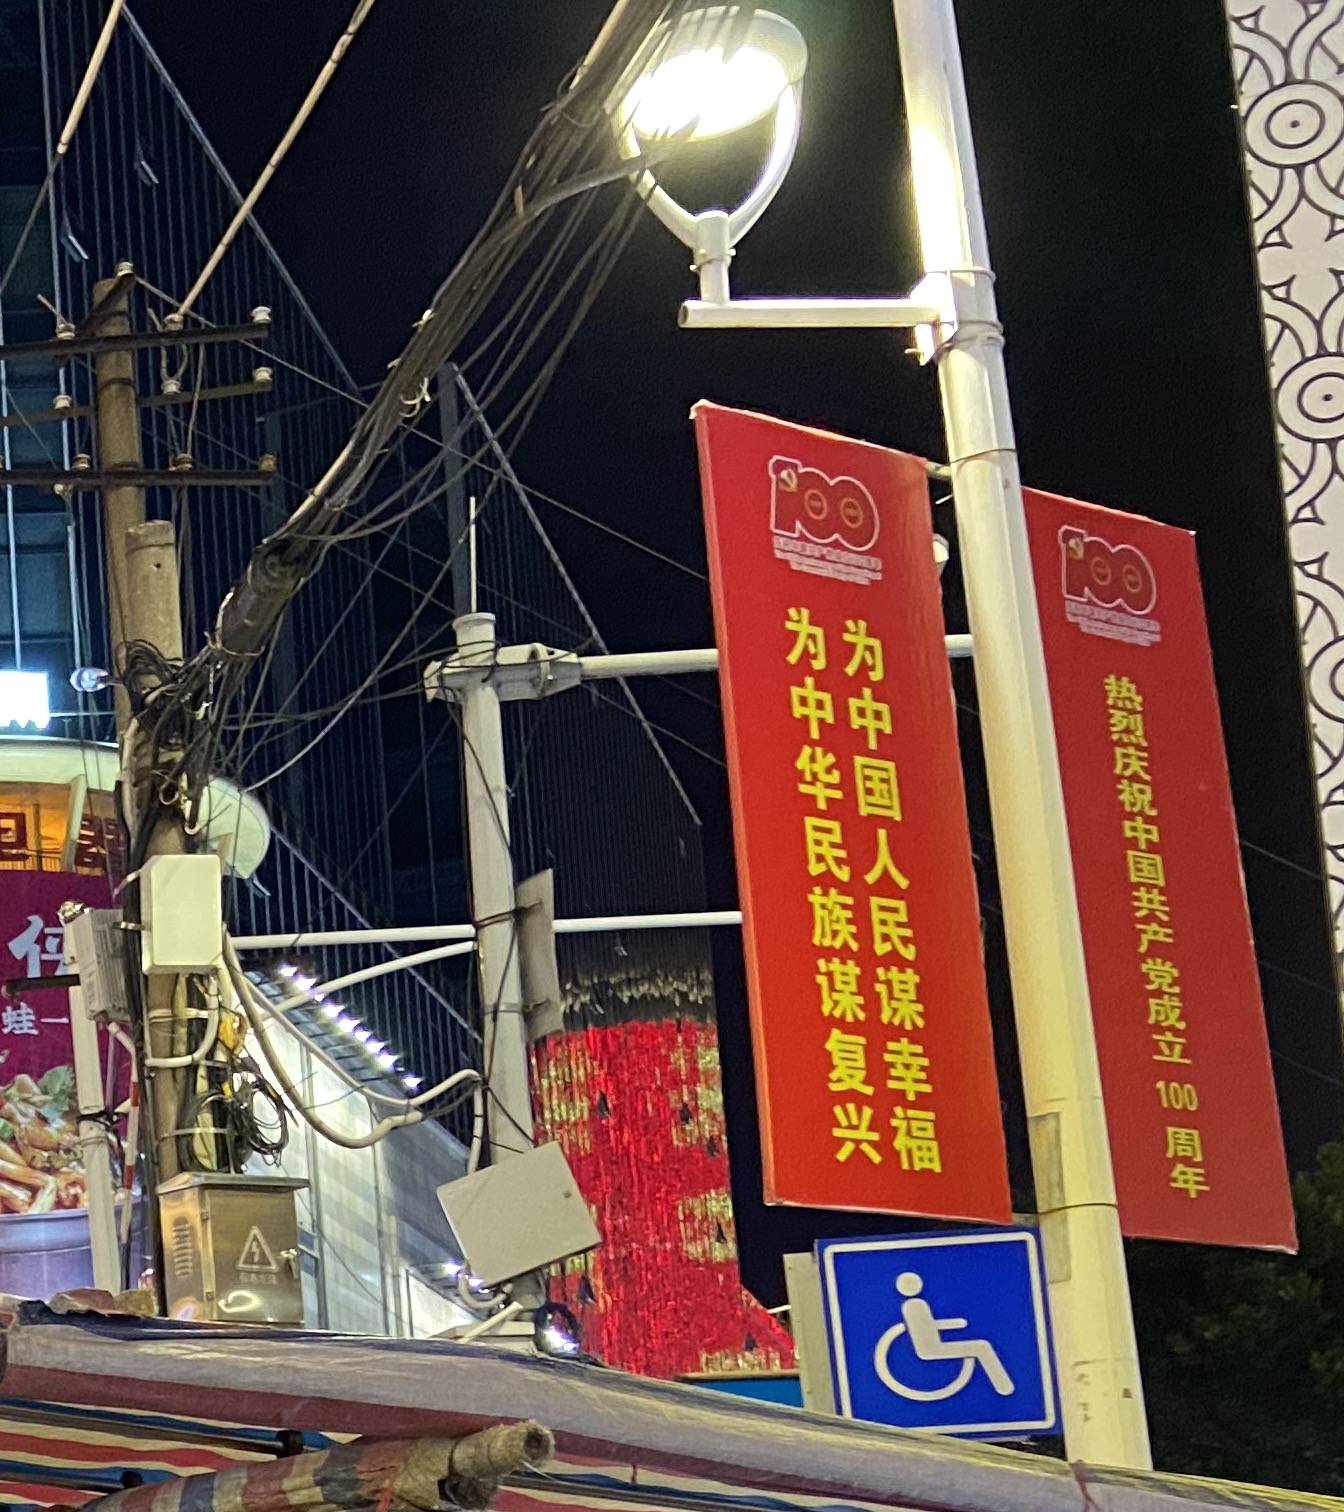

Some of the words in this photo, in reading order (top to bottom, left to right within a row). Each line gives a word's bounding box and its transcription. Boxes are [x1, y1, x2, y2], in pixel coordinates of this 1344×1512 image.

[784, 606, 881, 1165] 为中华民族谋复兴
[844, 619, 942, 1174] 为中国人民谋幸福
[1104, 673, 1192, 1065] 热烈庆祝中国共产党成立
[1155, 1080, 1199, 1113] 100
[1164, 1126, 1211, 1199] 周年
